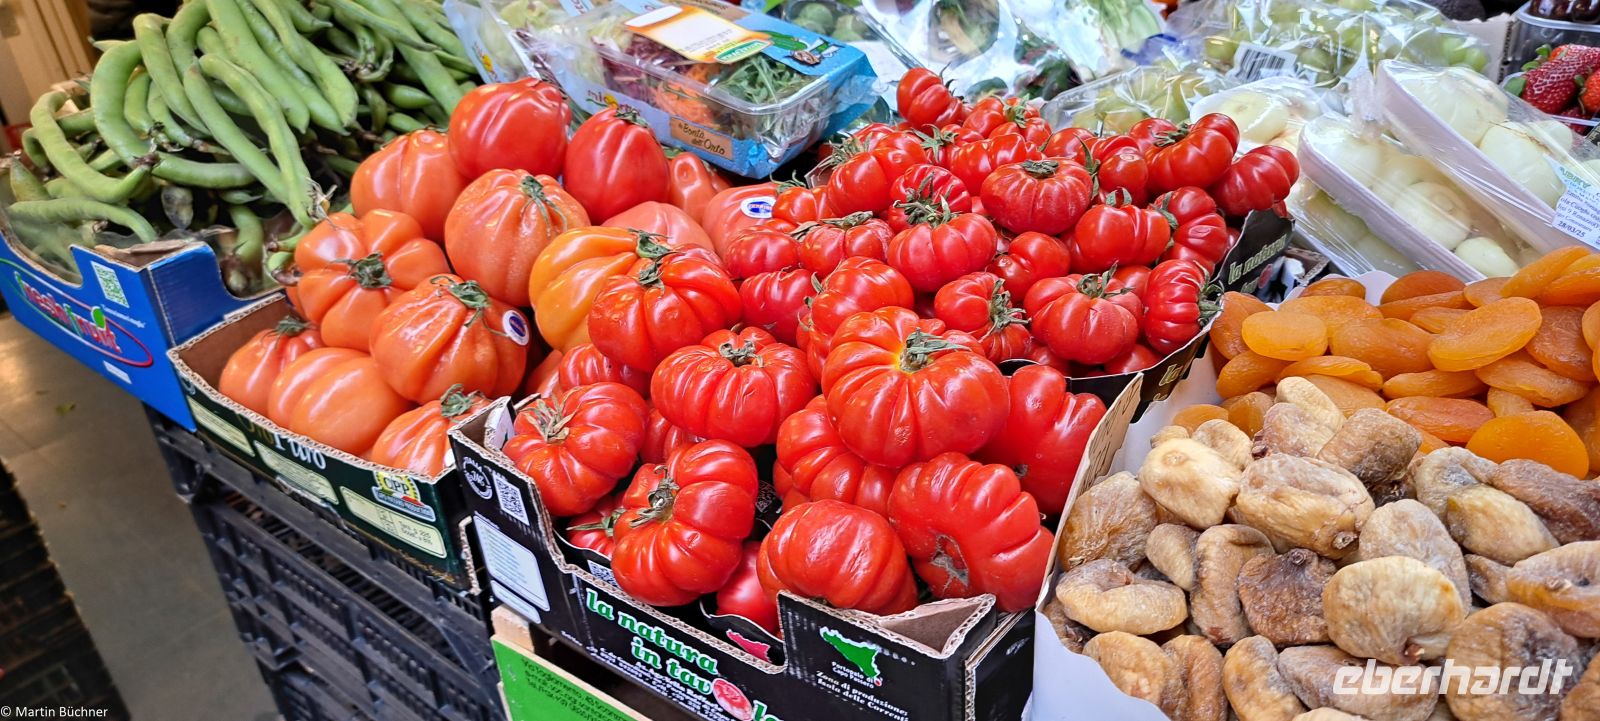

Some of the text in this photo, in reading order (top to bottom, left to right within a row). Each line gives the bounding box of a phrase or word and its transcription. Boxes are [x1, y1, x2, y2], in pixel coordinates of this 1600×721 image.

[586, 587, 615, 621] la
[617, 610, 719, 675] natura
[630, 636, 663, 670] in
[832, 661, 864, 680] Portopalo
[816, 670, 908, 716] Zona di produzione:
[832, 667, 875, 689] Capo Passero
[817, 678, 909, 721] Isola delle Correnti
